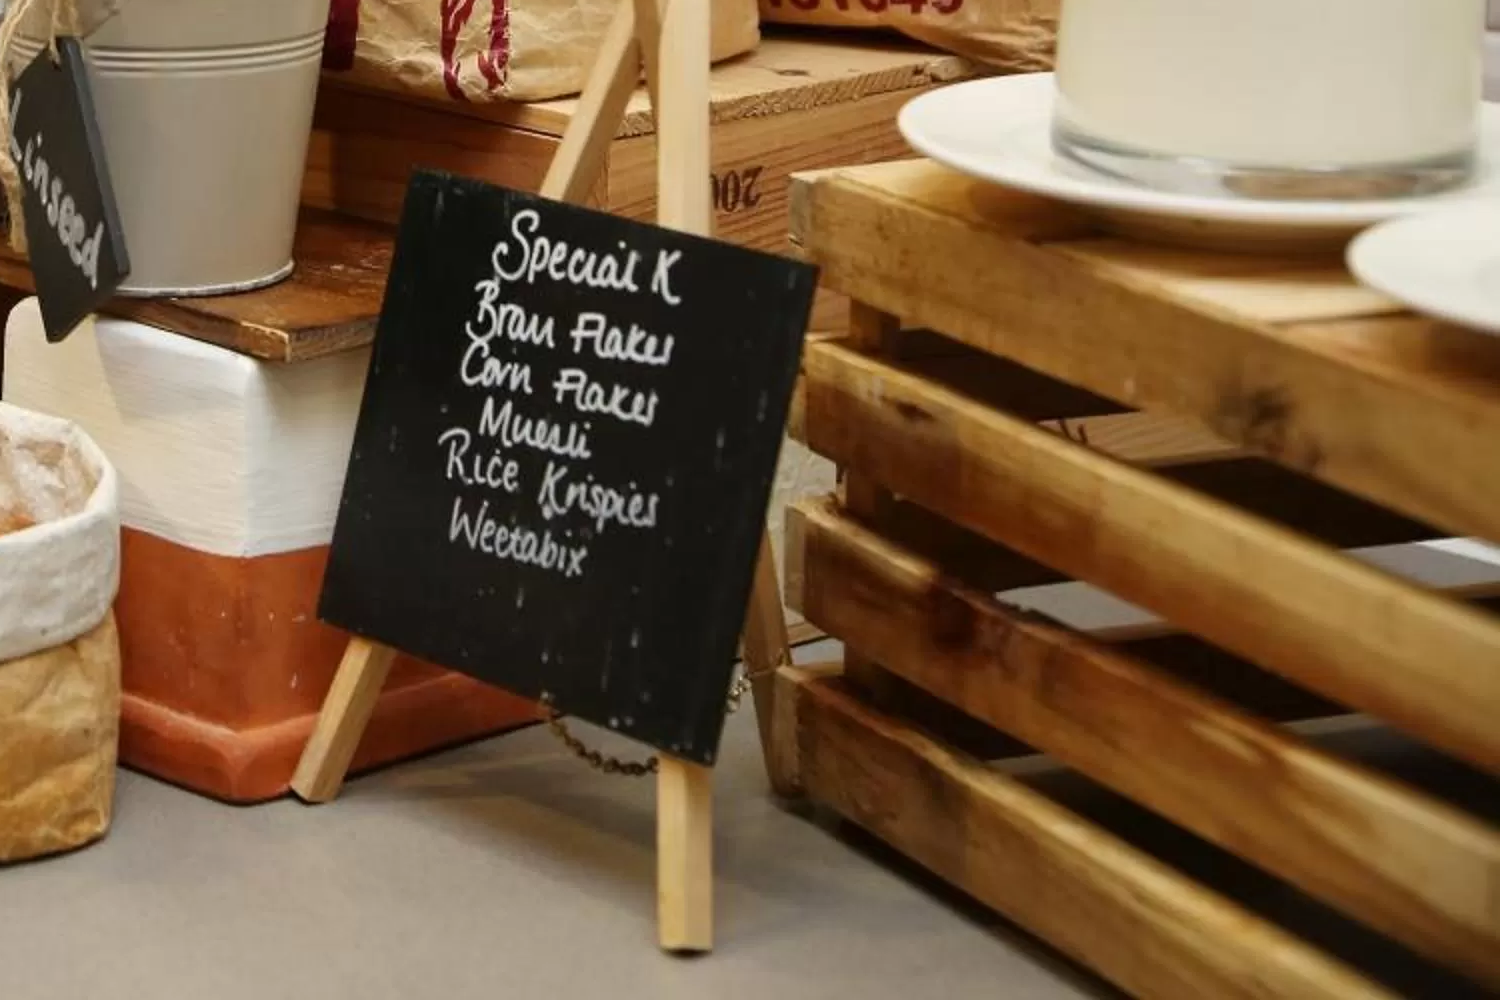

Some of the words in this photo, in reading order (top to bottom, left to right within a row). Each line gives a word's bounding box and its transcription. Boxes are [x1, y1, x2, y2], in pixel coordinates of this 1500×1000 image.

[492, 209, 638, 292] Special
[651, 248, 682, 305] K
[465, 279, 555, 349] Bran
[570, 311, 675, 365] Flakes
[461, 339, 533, 394] Corn
[553, 368, 659, 426] Flakes
[479, 396, 591, 459] Muesli
[438, 427, 519, 492] Rice
[537, 460, 660, 533] Krispies
[449, 496, 587, 577] Weetabix
